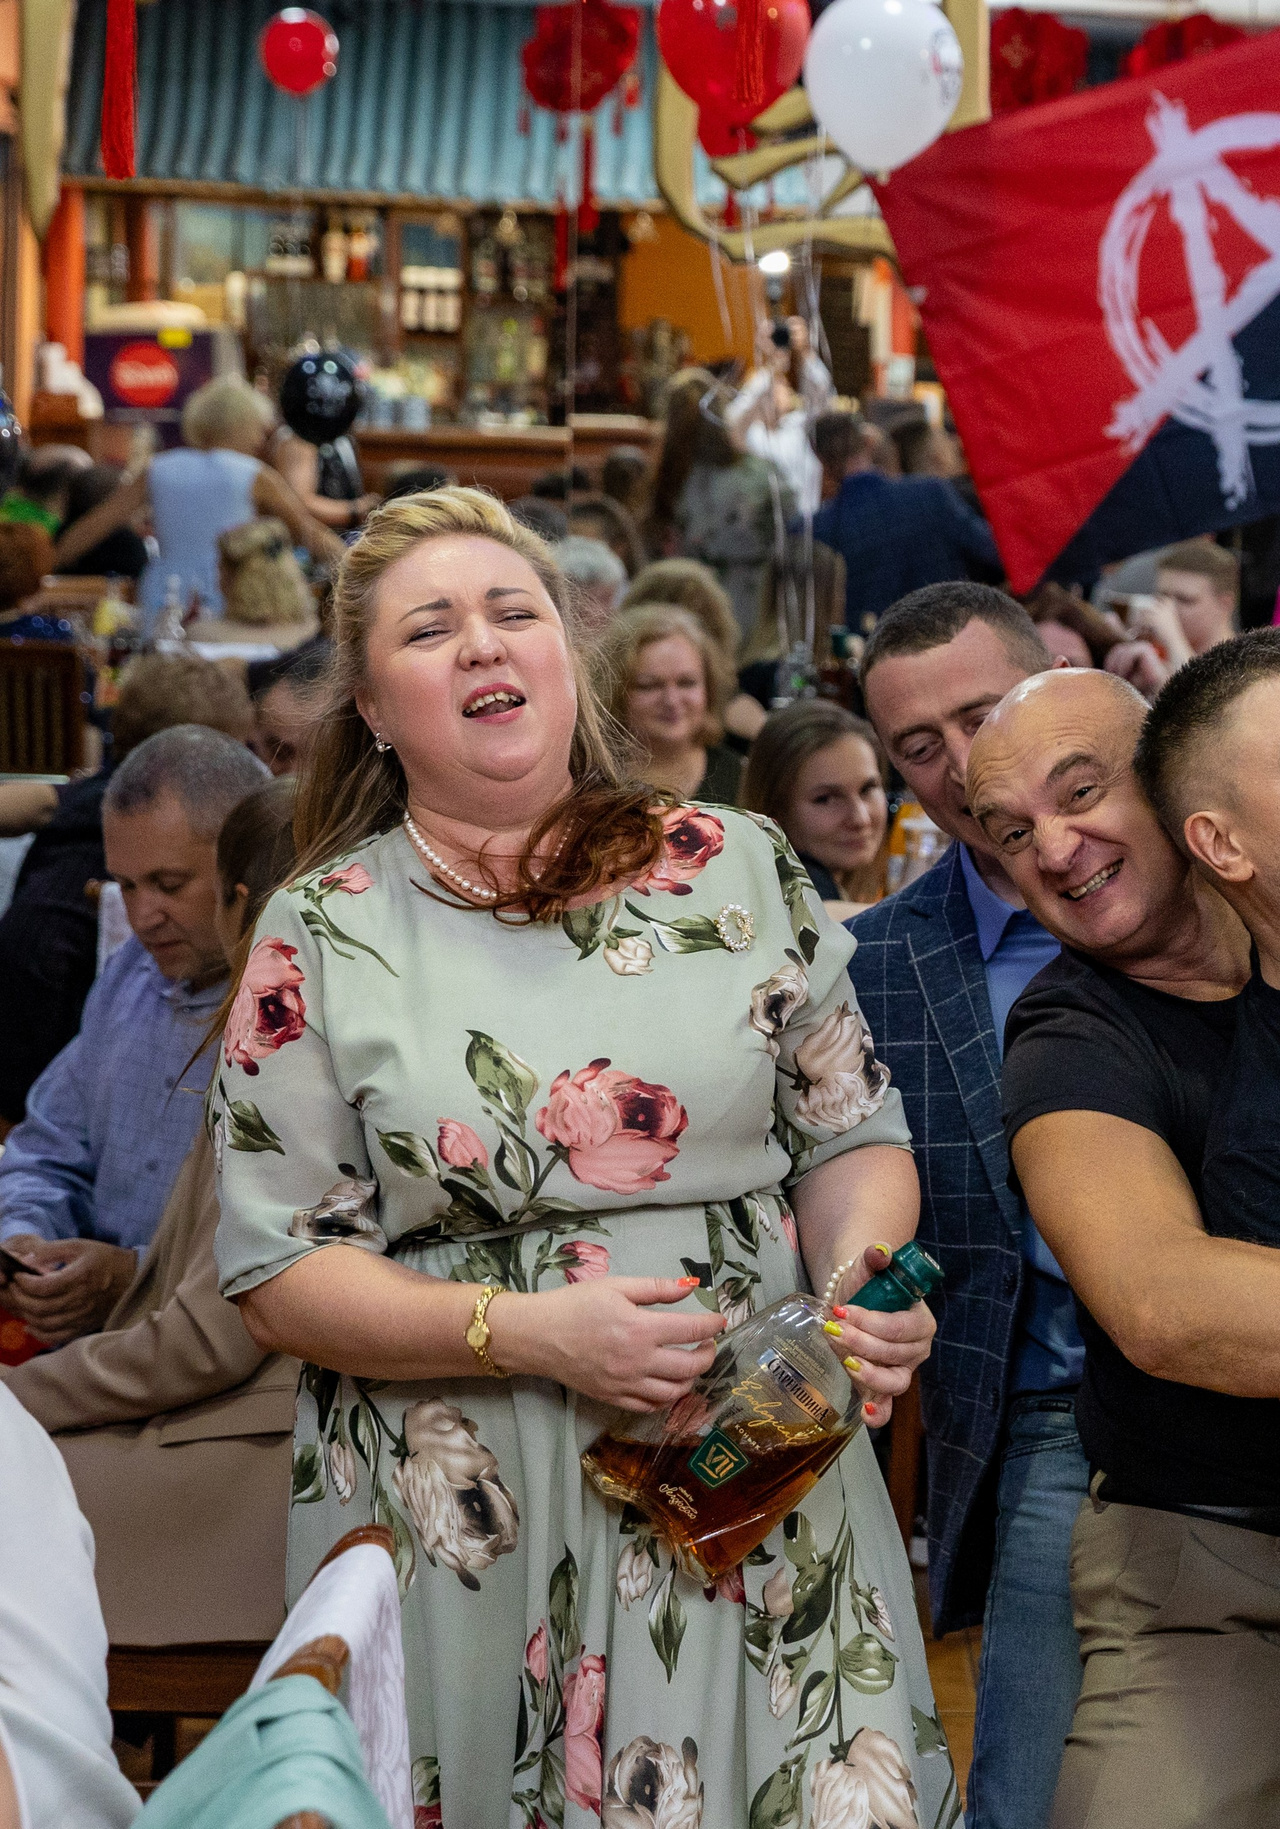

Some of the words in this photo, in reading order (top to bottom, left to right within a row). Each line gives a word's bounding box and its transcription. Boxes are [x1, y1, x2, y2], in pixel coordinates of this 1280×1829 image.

[731, 1372, 811, 1445] Enological
[767, 1358, 830, 1421] СТАРЕЙШИНА
[697, 1443, 739, 1479] VII
[734, 1423, 761, 1451] КОНЬЯК
